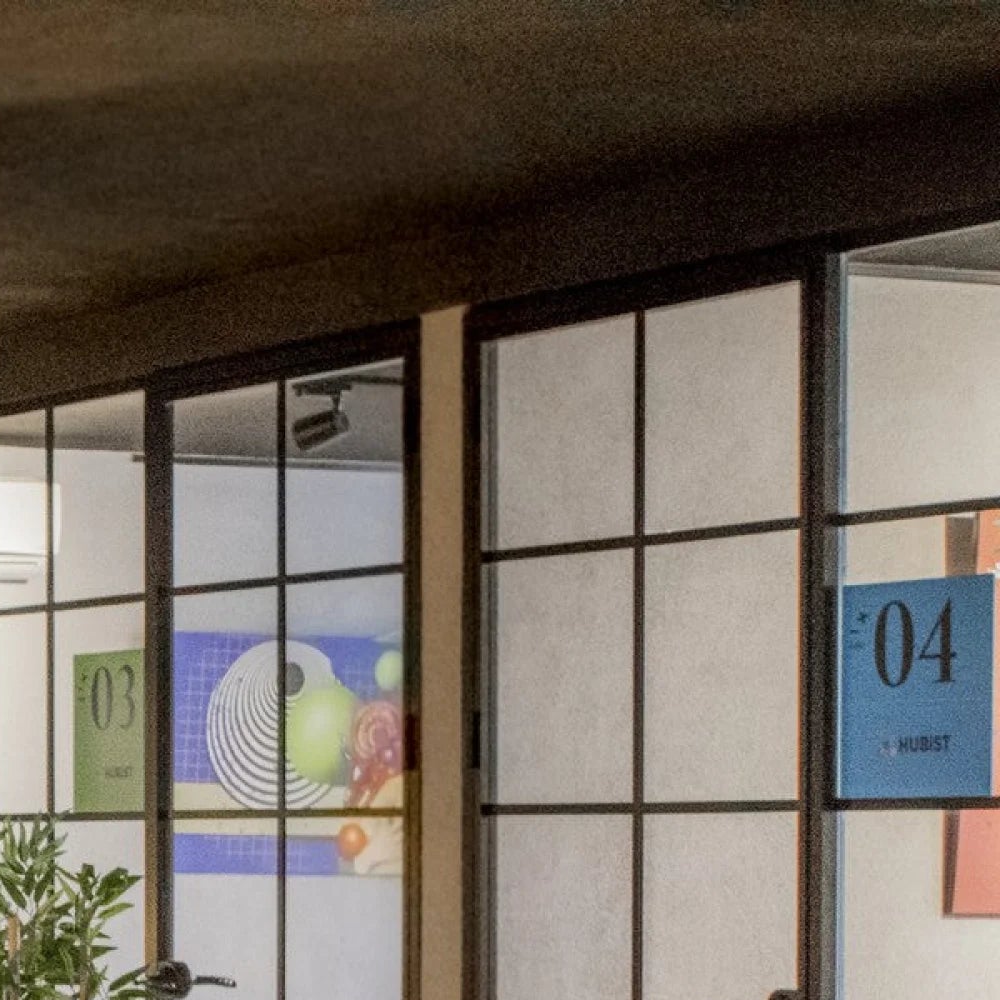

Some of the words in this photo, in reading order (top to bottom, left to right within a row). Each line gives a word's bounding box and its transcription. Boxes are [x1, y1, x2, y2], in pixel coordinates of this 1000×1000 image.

[873, 597, 957, 688] 04
[91, 664, 135, 731] 03
[897, 733, 952, 753] HUBIST
